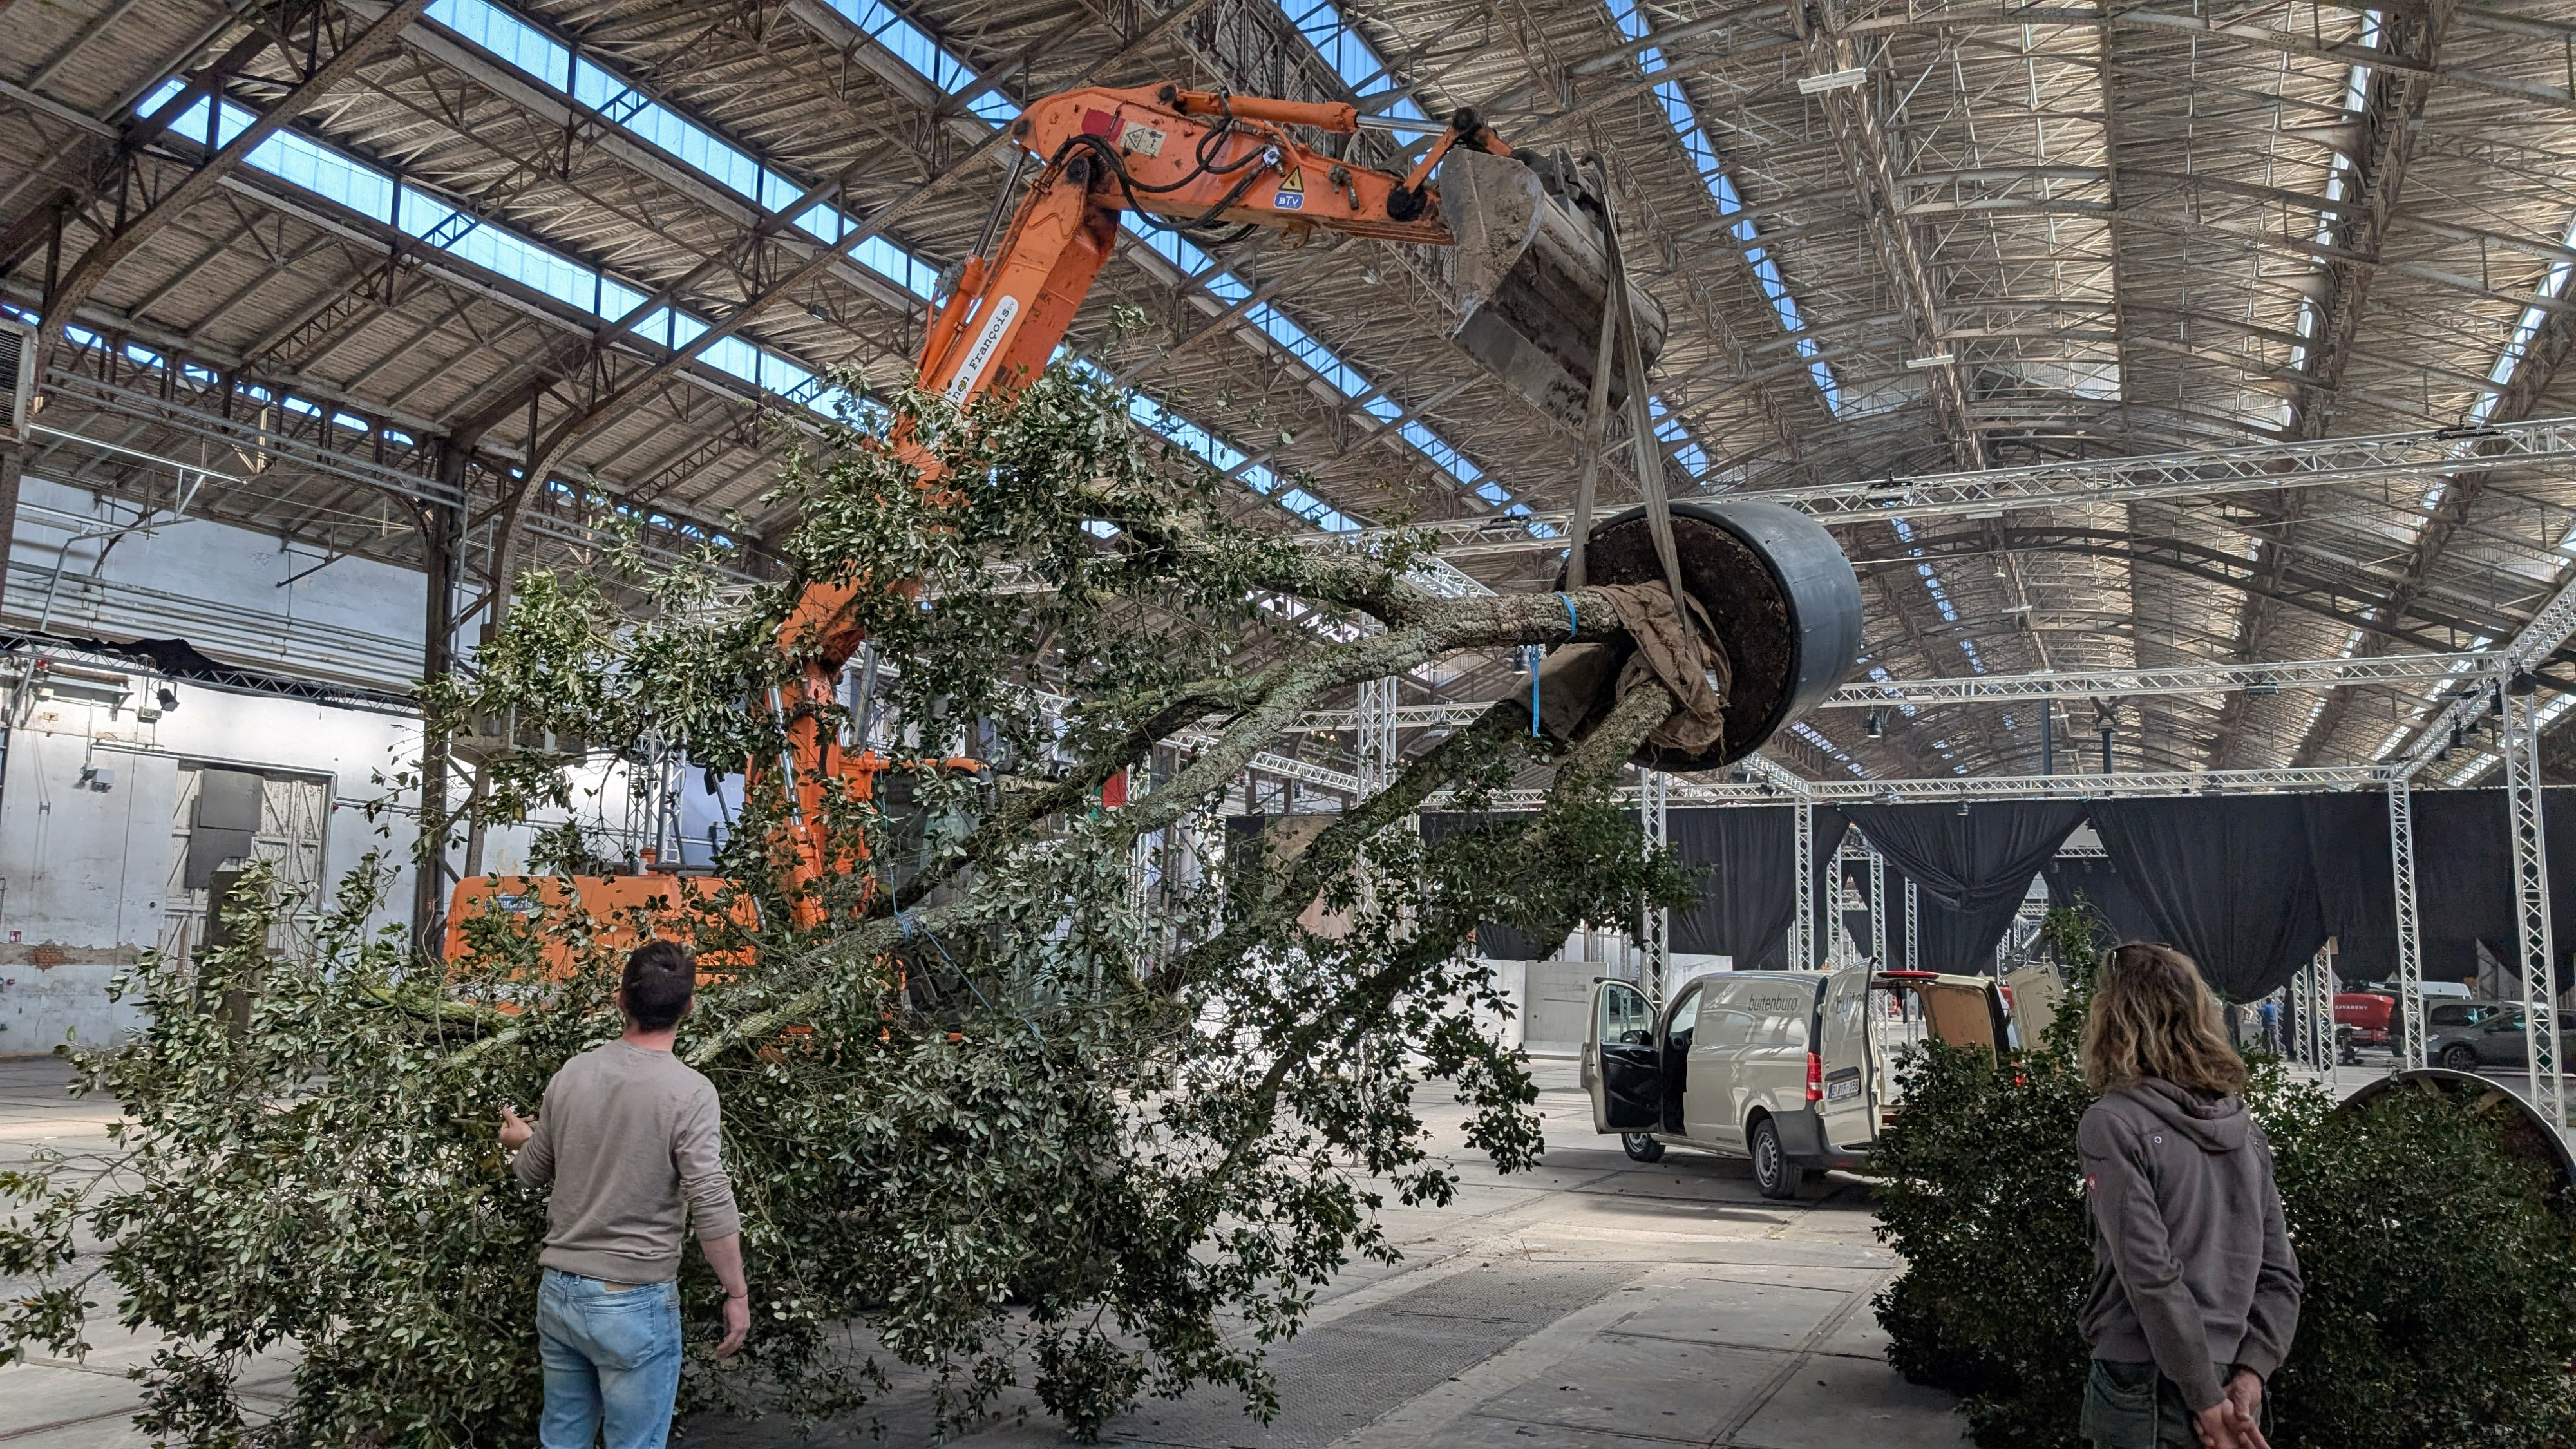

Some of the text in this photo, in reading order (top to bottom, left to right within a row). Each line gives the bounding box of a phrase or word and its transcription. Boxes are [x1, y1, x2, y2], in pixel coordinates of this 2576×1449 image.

[1279, 196, 1299, 206] BTV
[969, 307, 1010, 371] François
[1748, 992, 1798, 1012] buitenburo
